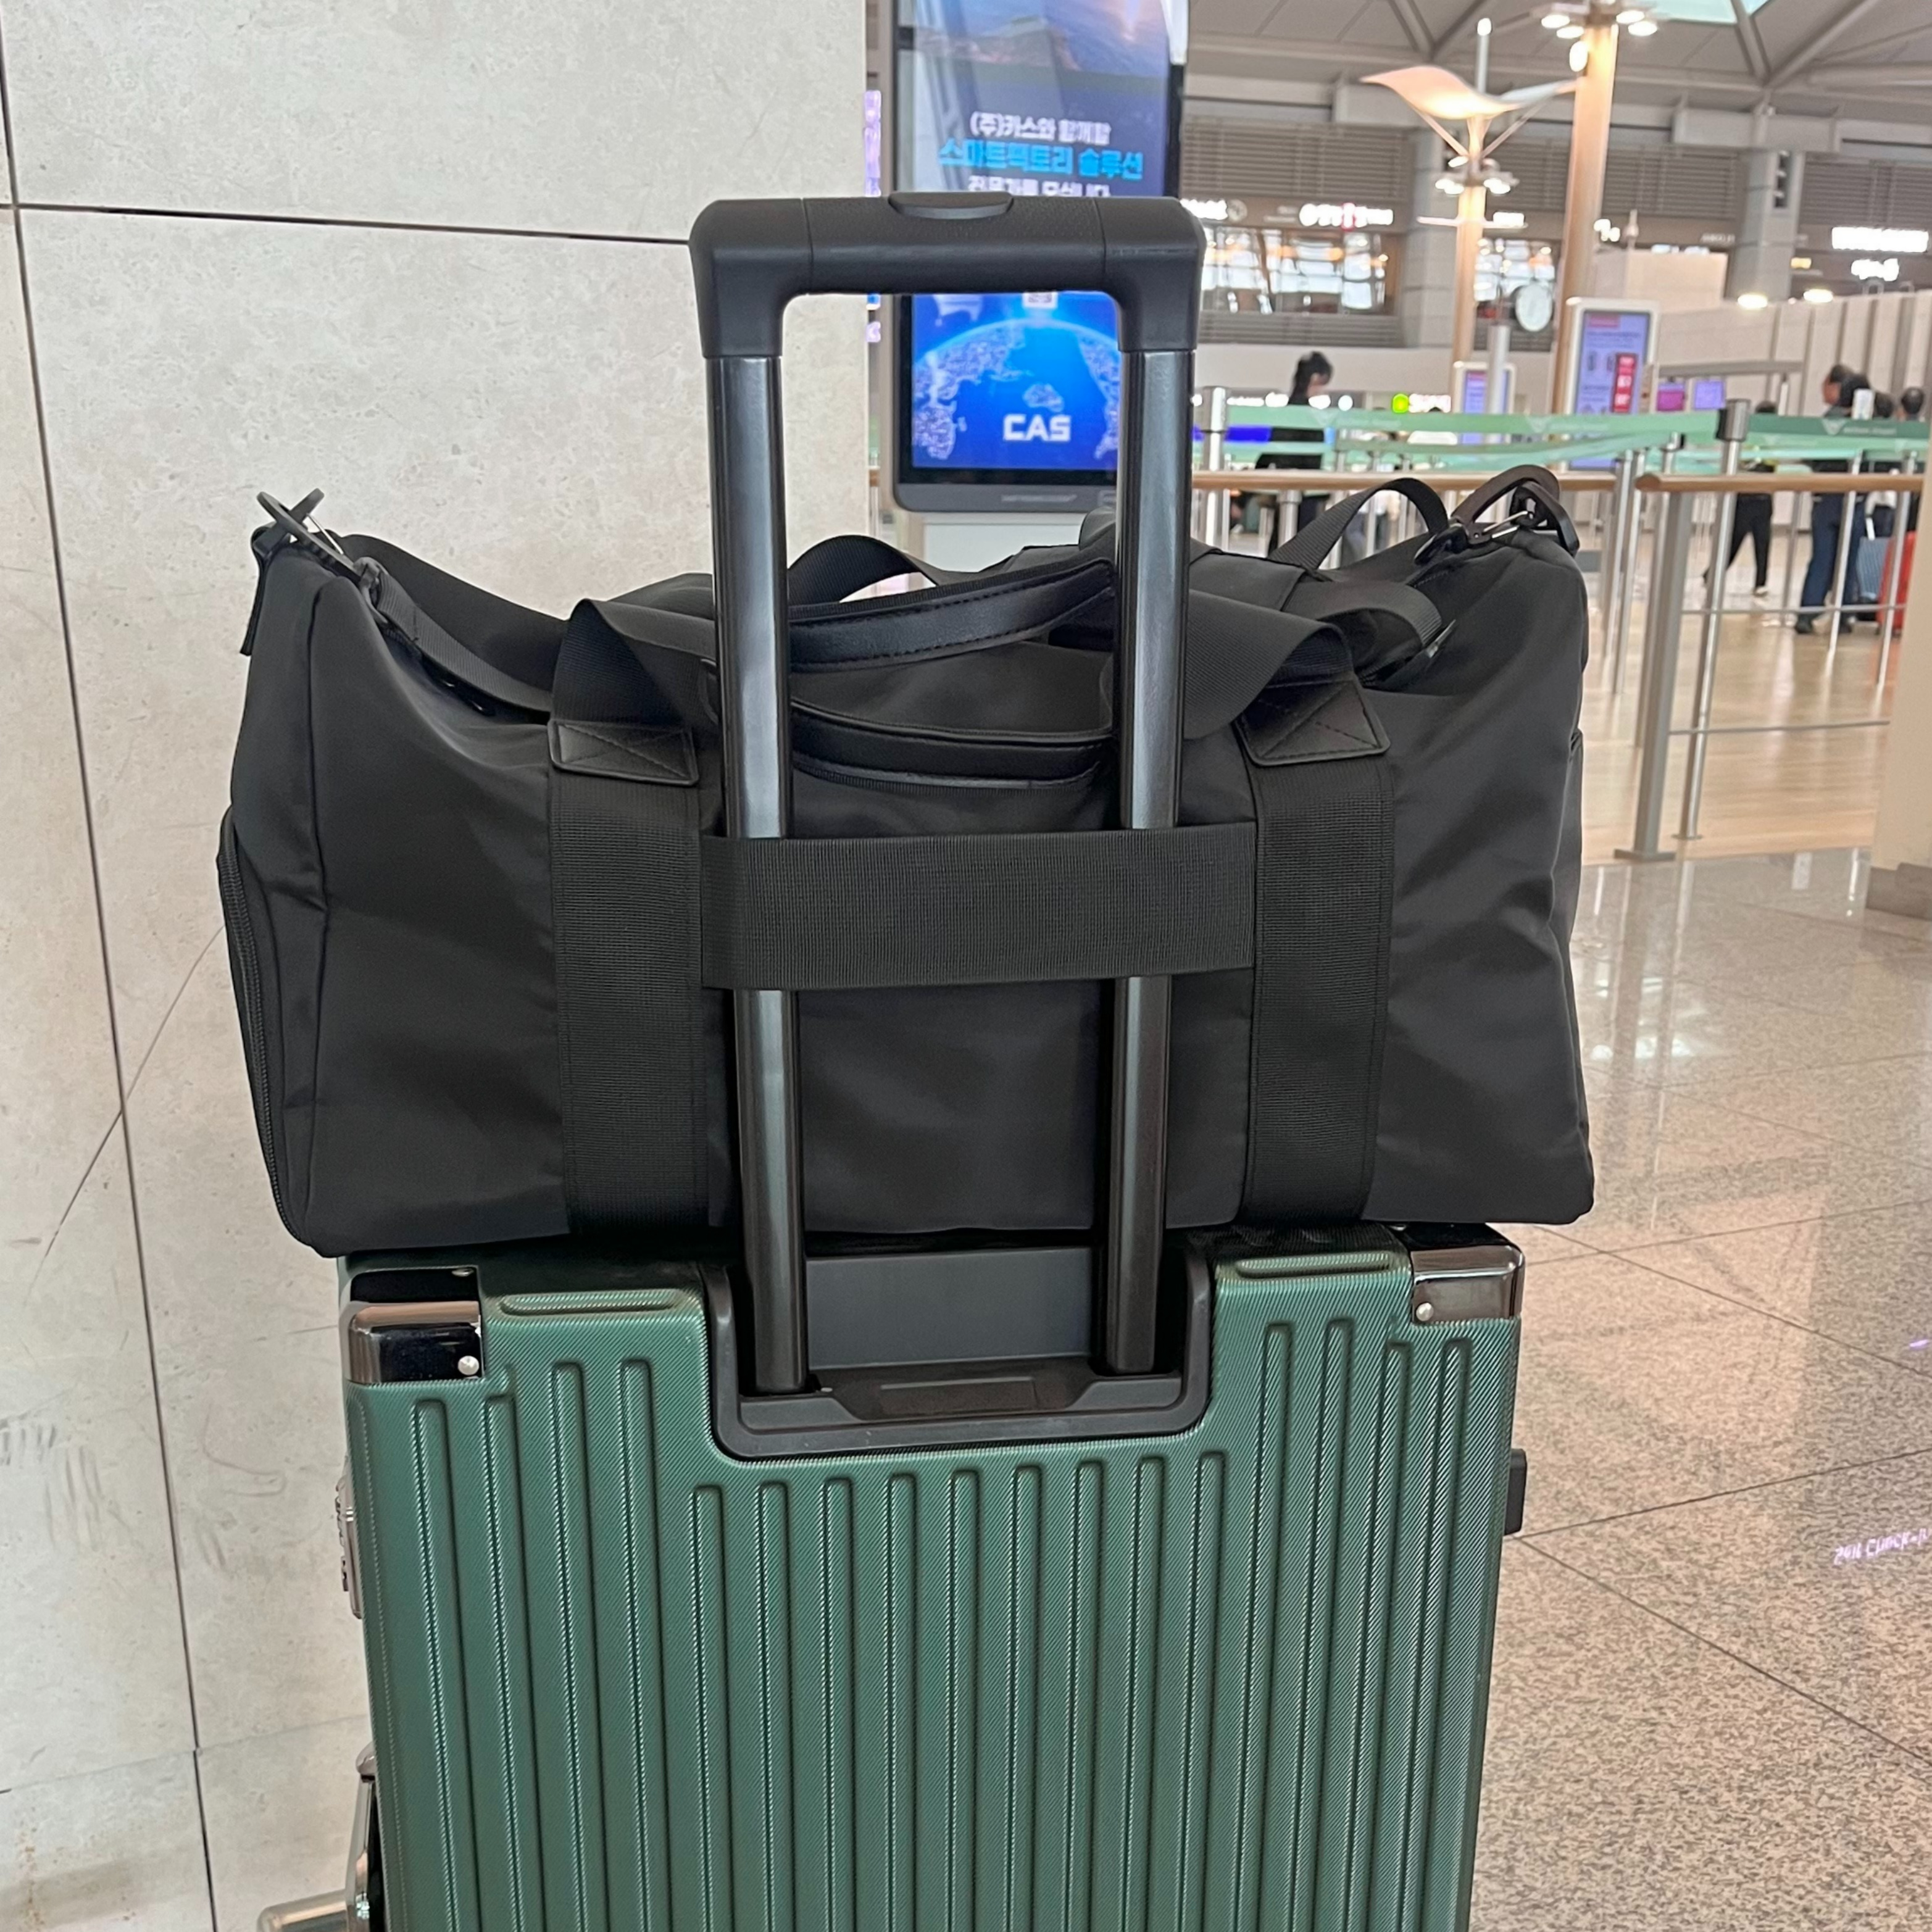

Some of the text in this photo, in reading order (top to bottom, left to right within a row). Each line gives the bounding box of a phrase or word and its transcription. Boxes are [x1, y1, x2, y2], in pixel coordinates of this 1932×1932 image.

[939, 138, 1143, 180] 스마트팩토리 솔루션
[1004, 414, 1071, 441] CAS
